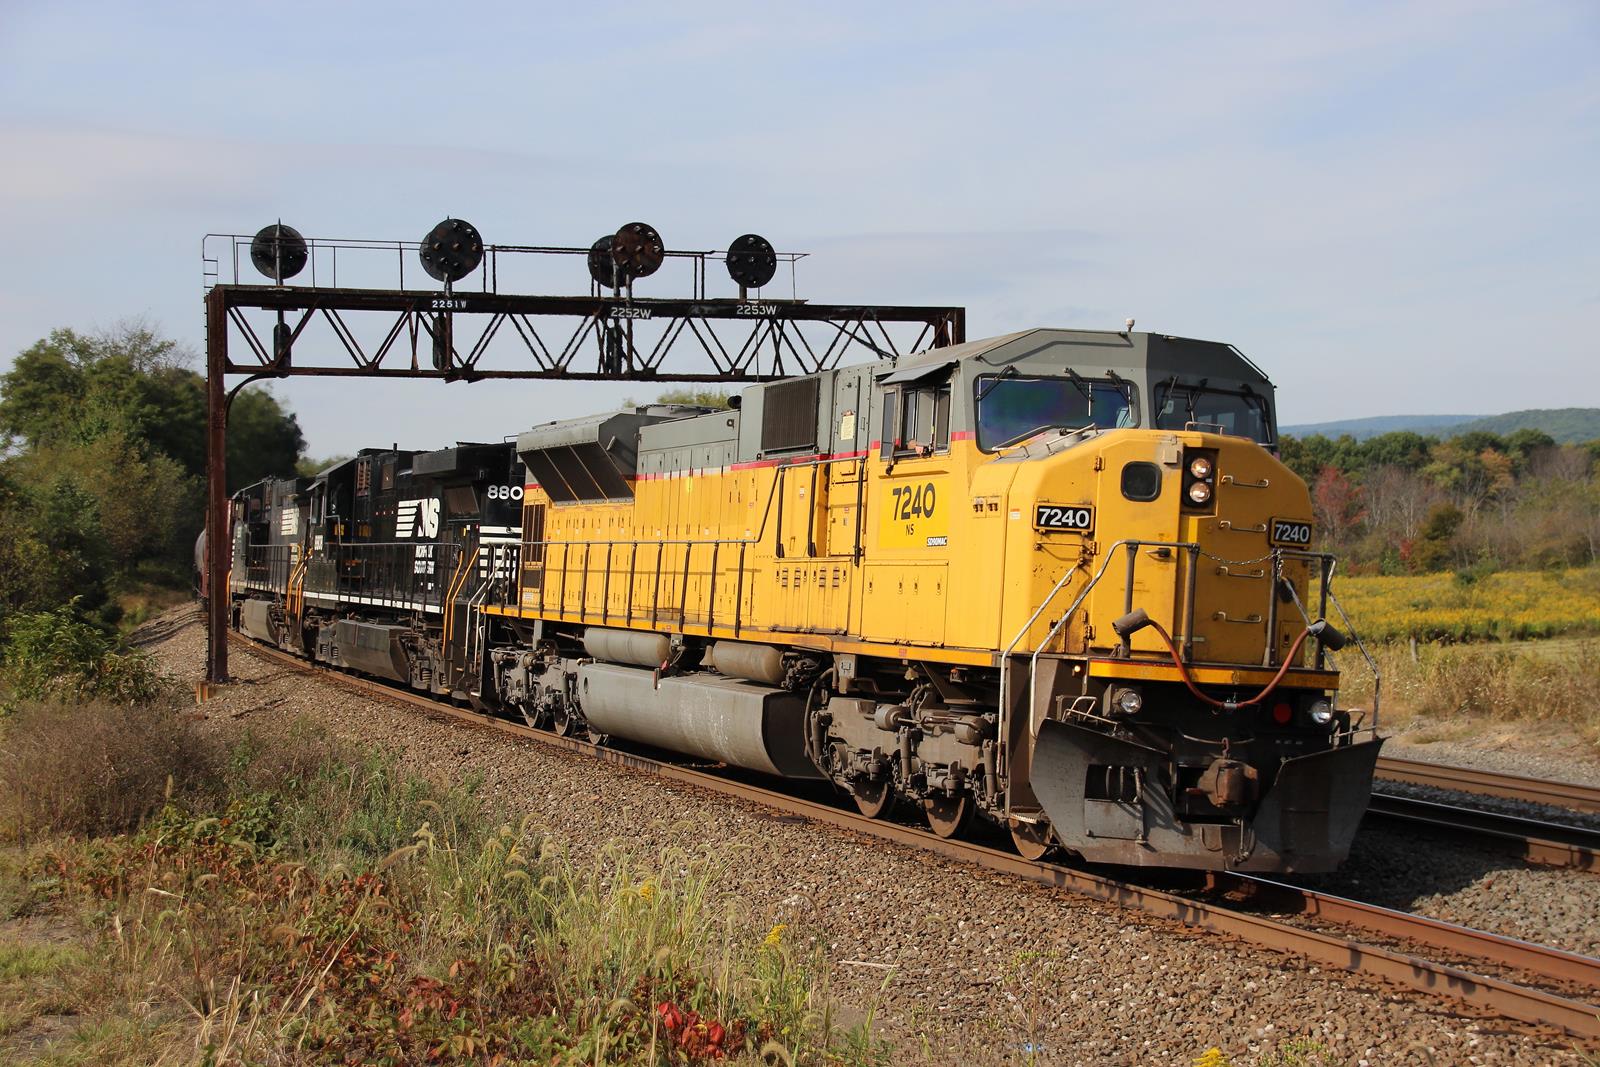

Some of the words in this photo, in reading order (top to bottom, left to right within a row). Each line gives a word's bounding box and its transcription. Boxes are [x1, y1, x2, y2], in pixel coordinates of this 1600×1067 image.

[432, 300, 467, 309] 2251W
[736, 305, 777, 316] 2253W
[610, 306, 652, 319] 2252W
[892, 482, 936, 521] 7240
[1038, 507, 1090, 527] 7240
[905, 523, 915, 536] NS
[1275, 524, 1310, 543] 7240
